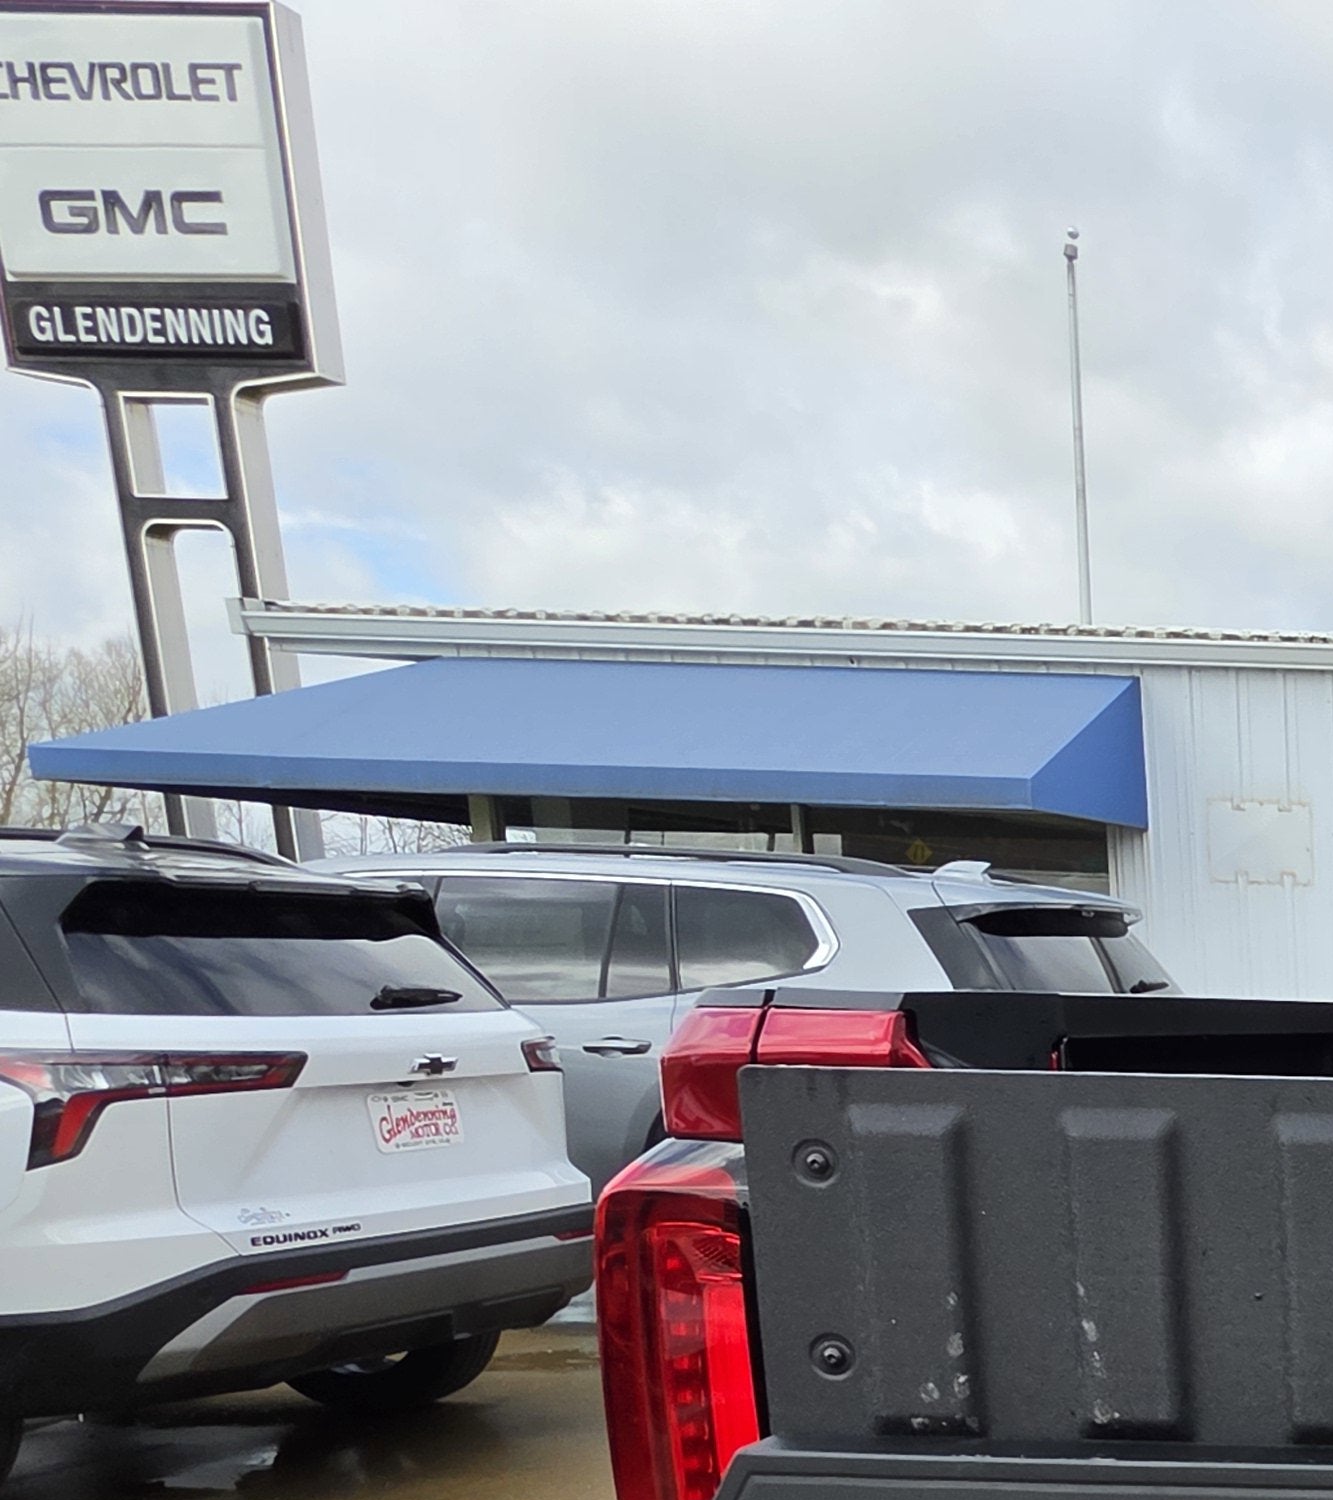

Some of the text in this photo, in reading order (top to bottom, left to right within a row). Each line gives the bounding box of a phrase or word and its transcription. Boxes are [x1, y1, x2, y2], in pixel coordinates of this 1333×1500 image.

[38, 189, 229, 235] GMC
[28, 305, 274, 346] GLENDENNING
[250, 1228, 329, 1247] EQUINOX
